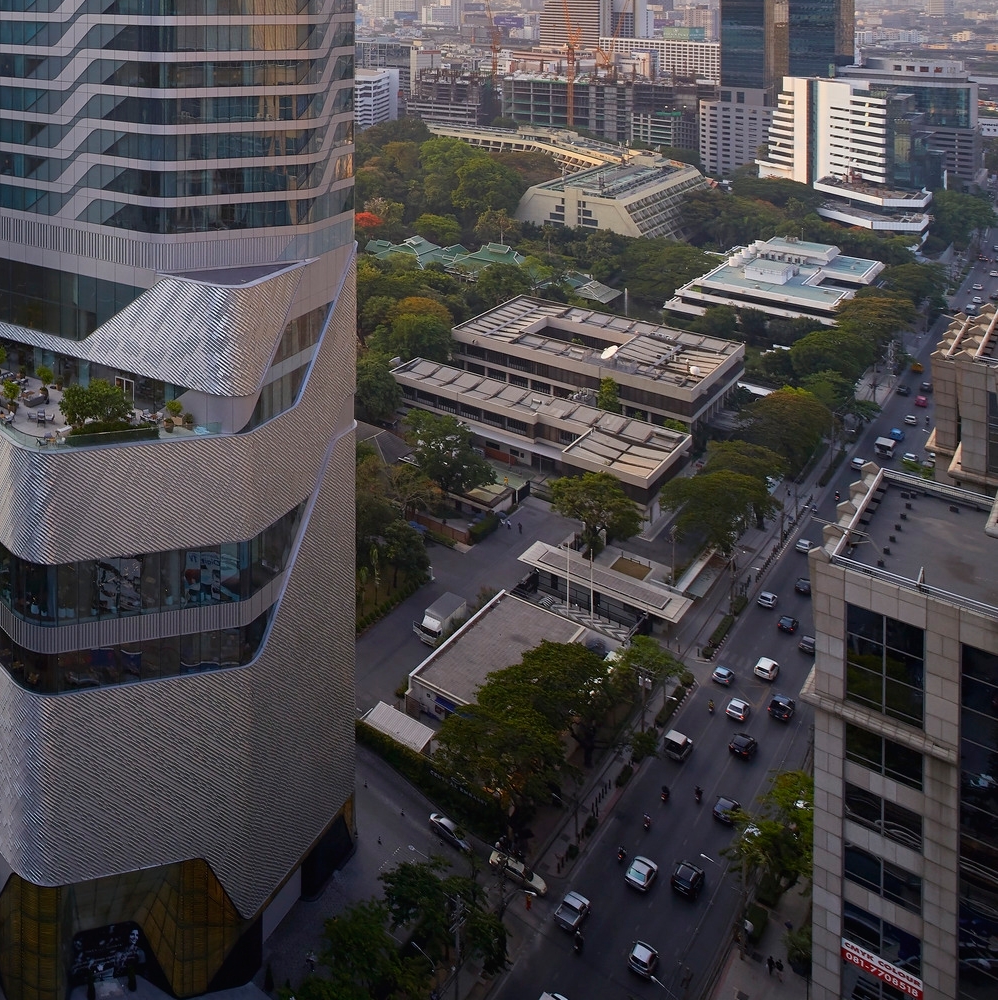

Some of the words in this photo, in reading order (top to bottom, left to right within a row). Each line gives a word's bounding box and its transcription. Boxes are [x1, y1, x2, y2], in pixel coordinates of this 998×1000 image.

[844, 941, 875, 962] CMYK
[877, 959, 922, 988] COLOUR
[845, 951, 919, 998] 081-7708518
